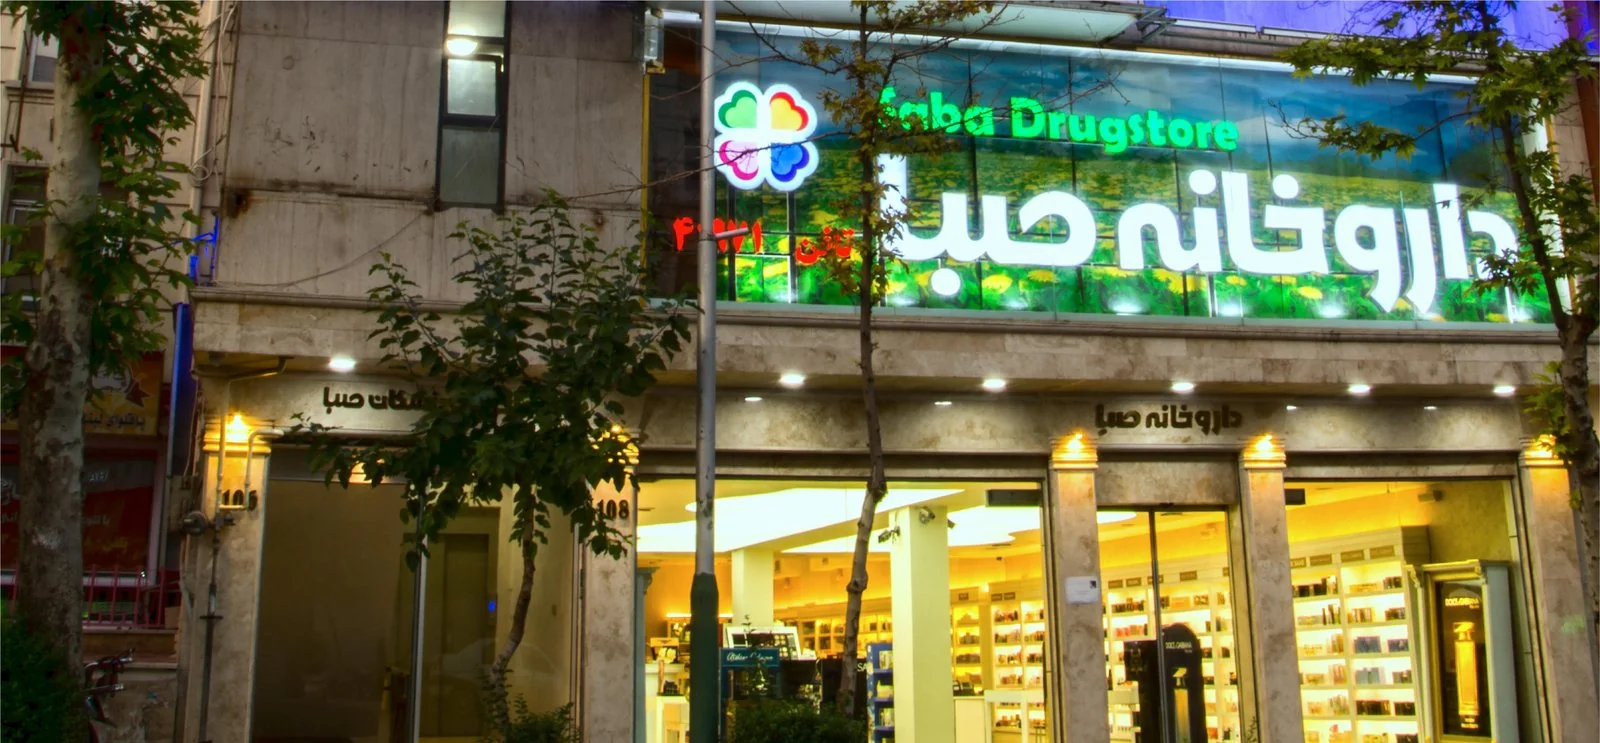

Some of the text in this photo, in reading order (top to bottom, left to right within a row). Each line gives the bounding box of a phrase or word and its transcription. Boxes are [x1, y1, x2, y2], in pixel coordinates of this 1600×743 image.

[1010, 96, 1240, 154] Drugstore
[876, 152, 1519, 315] داروخانه صبا
[322, 386, 365, 413] صبا
[1095, 404, 1243, 436] داروخانه صبا
[597, 499, 630, 520] 108
